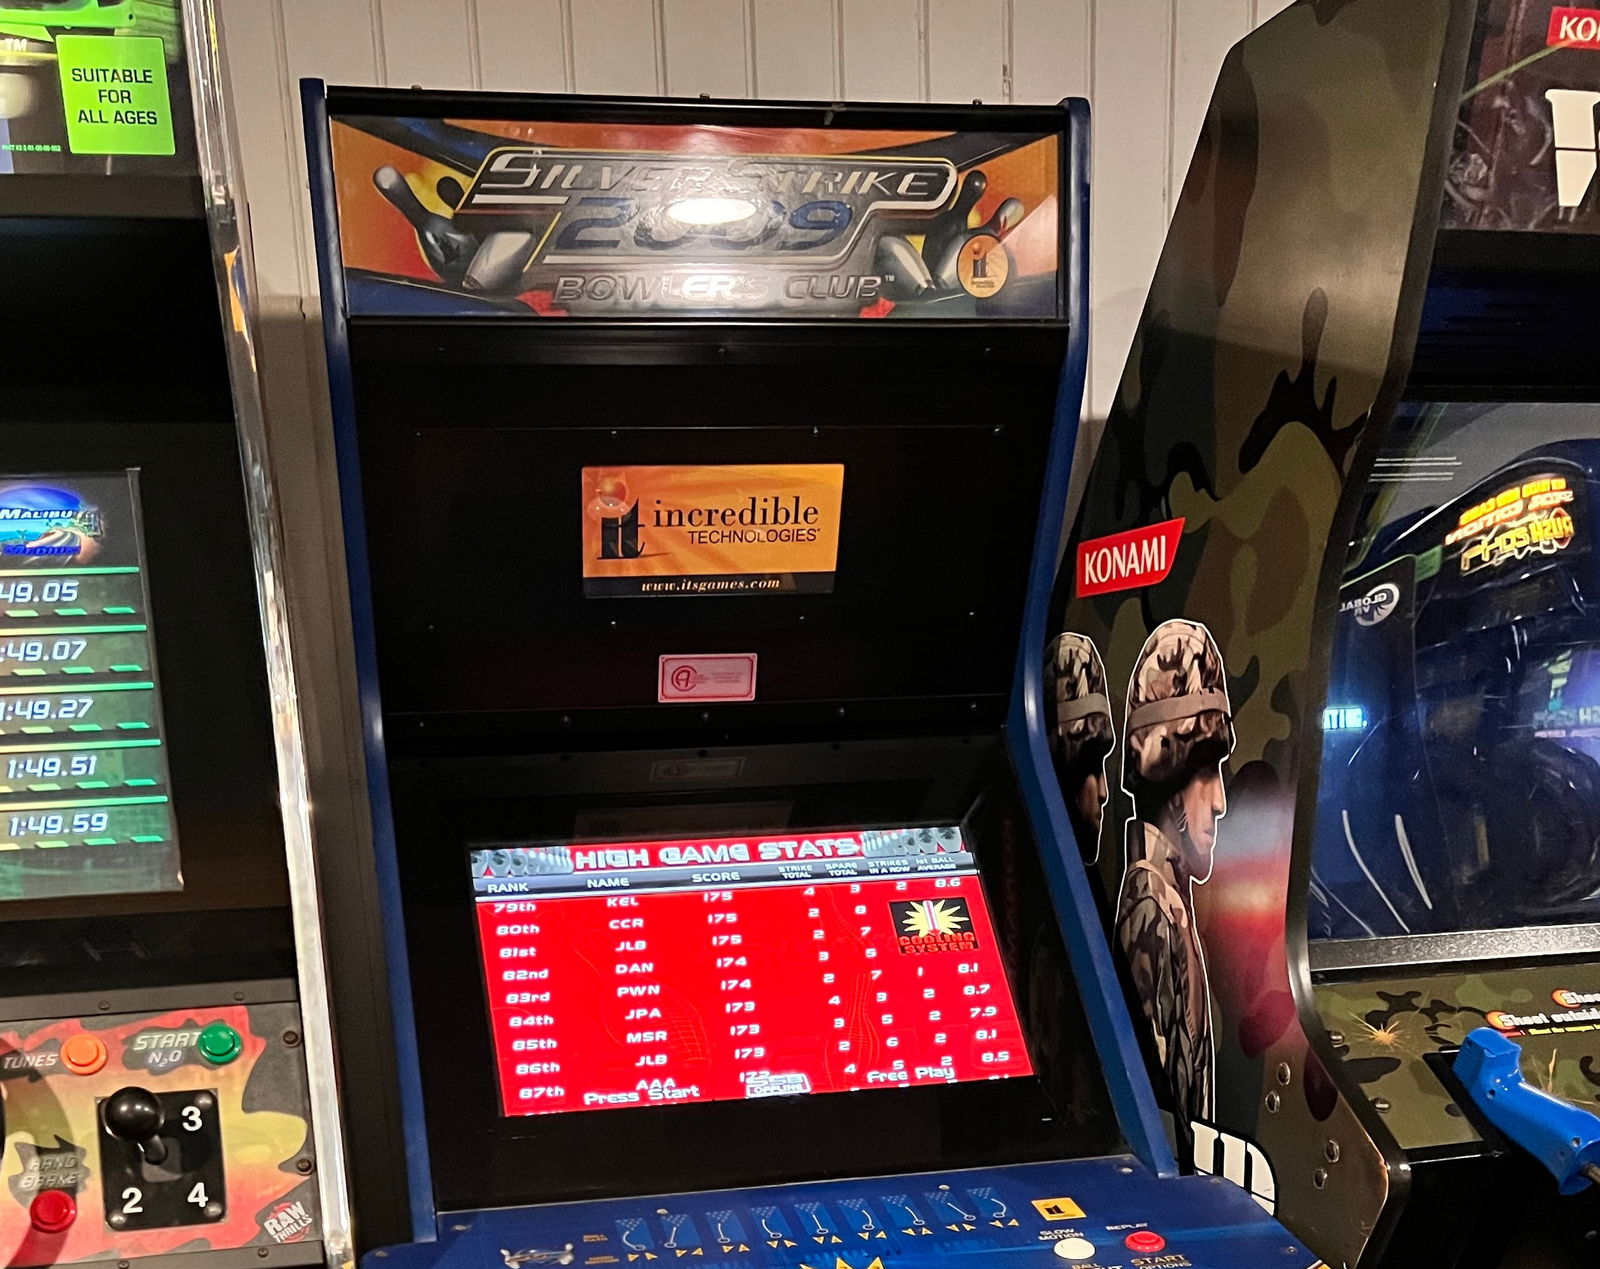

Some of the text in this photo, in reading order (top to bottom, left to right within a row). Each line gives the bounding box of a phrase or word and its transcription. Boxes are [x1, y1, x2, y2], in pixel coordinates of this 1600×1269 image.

[1559, 15, 1600, 42] KO
[72, 68, 153, 84] SUITABLE
[98, 89, 131, 104] FOR
[77, 109, 158, 125] ALL AGES
[480, 152, 938, 197] SILVER STRIKE
[555, 197, 852, 250] 2009
[784, 275, 882, 300] CLUB
[653, 496, 818, 528] incredible
[688, 528, 817, 544] TECHNOLOGIES
[1085, 537, 1166, 584] KONAMI
[642, 578, 780, 592] www.itsgames.com
[7, 755, 97, 779] 1:49.51
[10, 812, 108, 836] 1:49.59
[575, 838, 860, 869] HIGH GAME STATS
[868, 859, 908, 868] STRIKES
[778, 865, 812, 873] STRIKE
[782, 871, 811, 879] TOTAL
[829, 868, 857, 876] TOTAL
[917, 863, 956, 871] AVERAGE
[487, 872, 740, 893] RANK NAME SCORE
[494, 901, 536, 913] 79th
[607, 896, 639, 907] KEL
[704, 890, 733, 902] 175
[496, 924, 540, 936] 80th
[609, 918, 643, 929] CCR
[708, 913, 737, 923] 175
[500, 947, 536, 958] 81st
[616, 940, 646, 951] JLB
[712, 935, 742, 945] 175
[899, 932, 975, 946] COOLING
[904, 942, 974, 954] SYSTEM
[503, 969, 548, 981] 82nd
[616, 963, 653, 974] DAN
[717, 957, 747, 967] 174
[506, 992, 550, 1004] 83rd
[617, 985, 660, 997] PWN
[721, 979, 751, 990] 174
[509, 1015, 554, 1027] 84th
[625, 1008, 661, 1020] JPA
[726, 1001, 755, 1013] 173
[1551, 1007, 1600, 1023] outsid
[133, 1031, 202, 1051] START
[512, 1038, 557, 1051] 85th
[627, 1031, 667, 1043] MSR
[730, 1024, 760, 1036] 173
[4, 1053, 58, 1069] TUNES
[516, 1062, 560, 1075] 86th
[635, 1054, 667, 1066] JLB
[735, 1047, 765, 1059] 173
[867, 1067, 955, 1083] Free Play
[519, 1086, 564, 1099] 87th
[584, 1085, 700, 1105] Press Start
[181, 1106, 203, 1132] 3
[29, 1156, 77, 1171] HAND
[22, 1173, 79, 1190] BRAKE
[122, 1183, 208, 1213] 2 4
[264, 1201, 305, 1236] RAW
[273, 1214, 312, 1243] THRILLS
[1105, 1223, 1148, 1231] REPLAY
[1038, 1232, 1084, 1241] MOTION
[1040, 1228, 1074, 1236] SLOW
[1130, 1254, 1185, 1266] START
